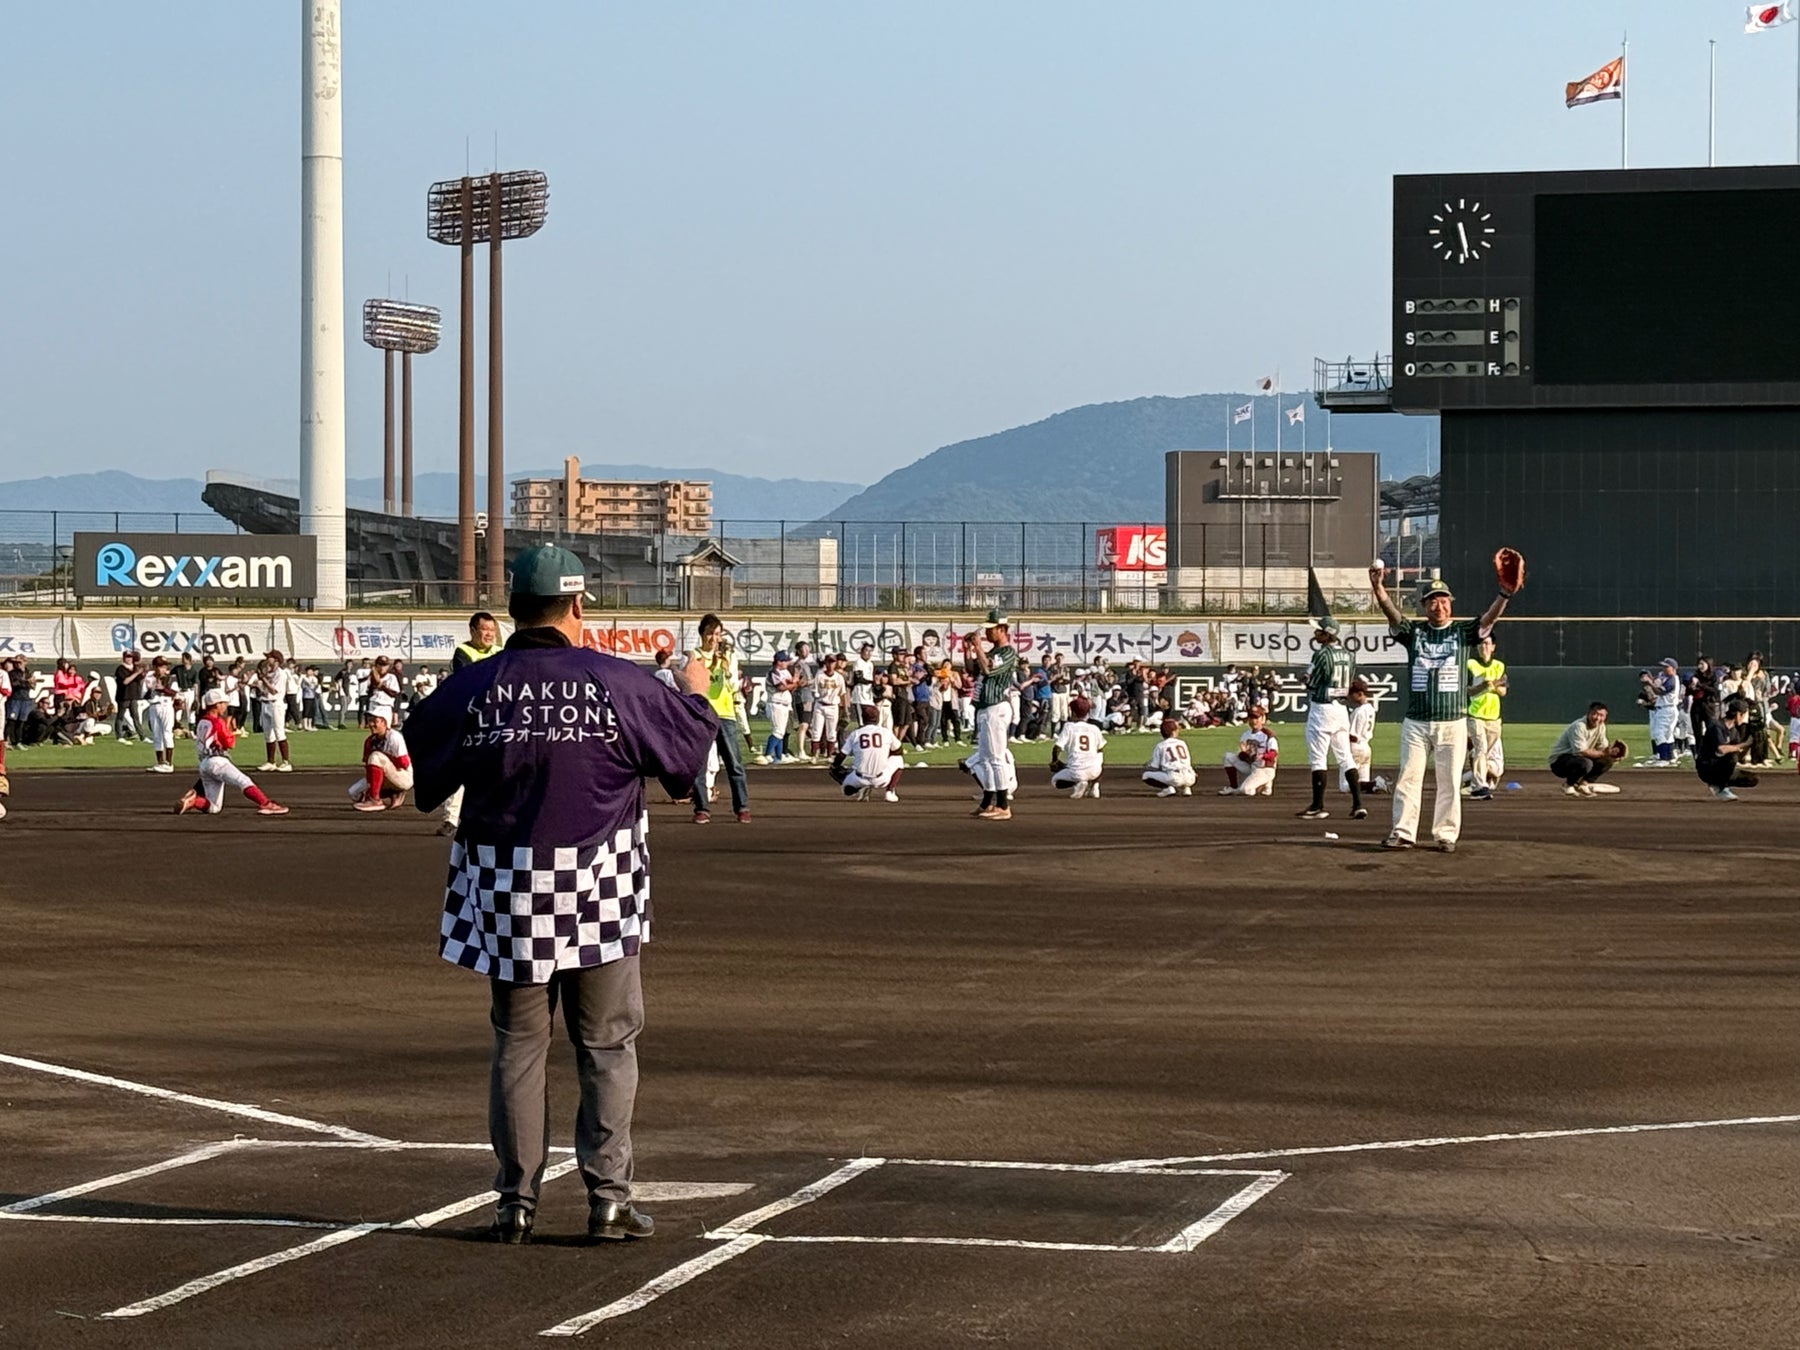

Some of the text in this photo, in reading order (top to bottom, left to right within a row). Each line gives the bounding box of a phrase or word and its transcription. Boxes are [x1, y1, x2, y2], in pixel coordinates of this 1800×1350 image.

[1405, 300, 1416, 314] B
[1489, 299, 1501, 313] H
[1405, 332, 1416, 345] S
[1489, 331, 1500, 344] E
[1404, 363, 1416, 376] O
[96, 541, 293, 589] Rexxam
[111, 622, 254, 655] Rexxam
[946, 631, 1173, 656] カラオールストーン
[1234, 632, 1302, 652] FUSO
[521, 704, 617, 727] STONE
[859, 732, 883, 749] 60
[1078, 735, 1090, 752] 9
[1165, 744, 1188, 762] 10
